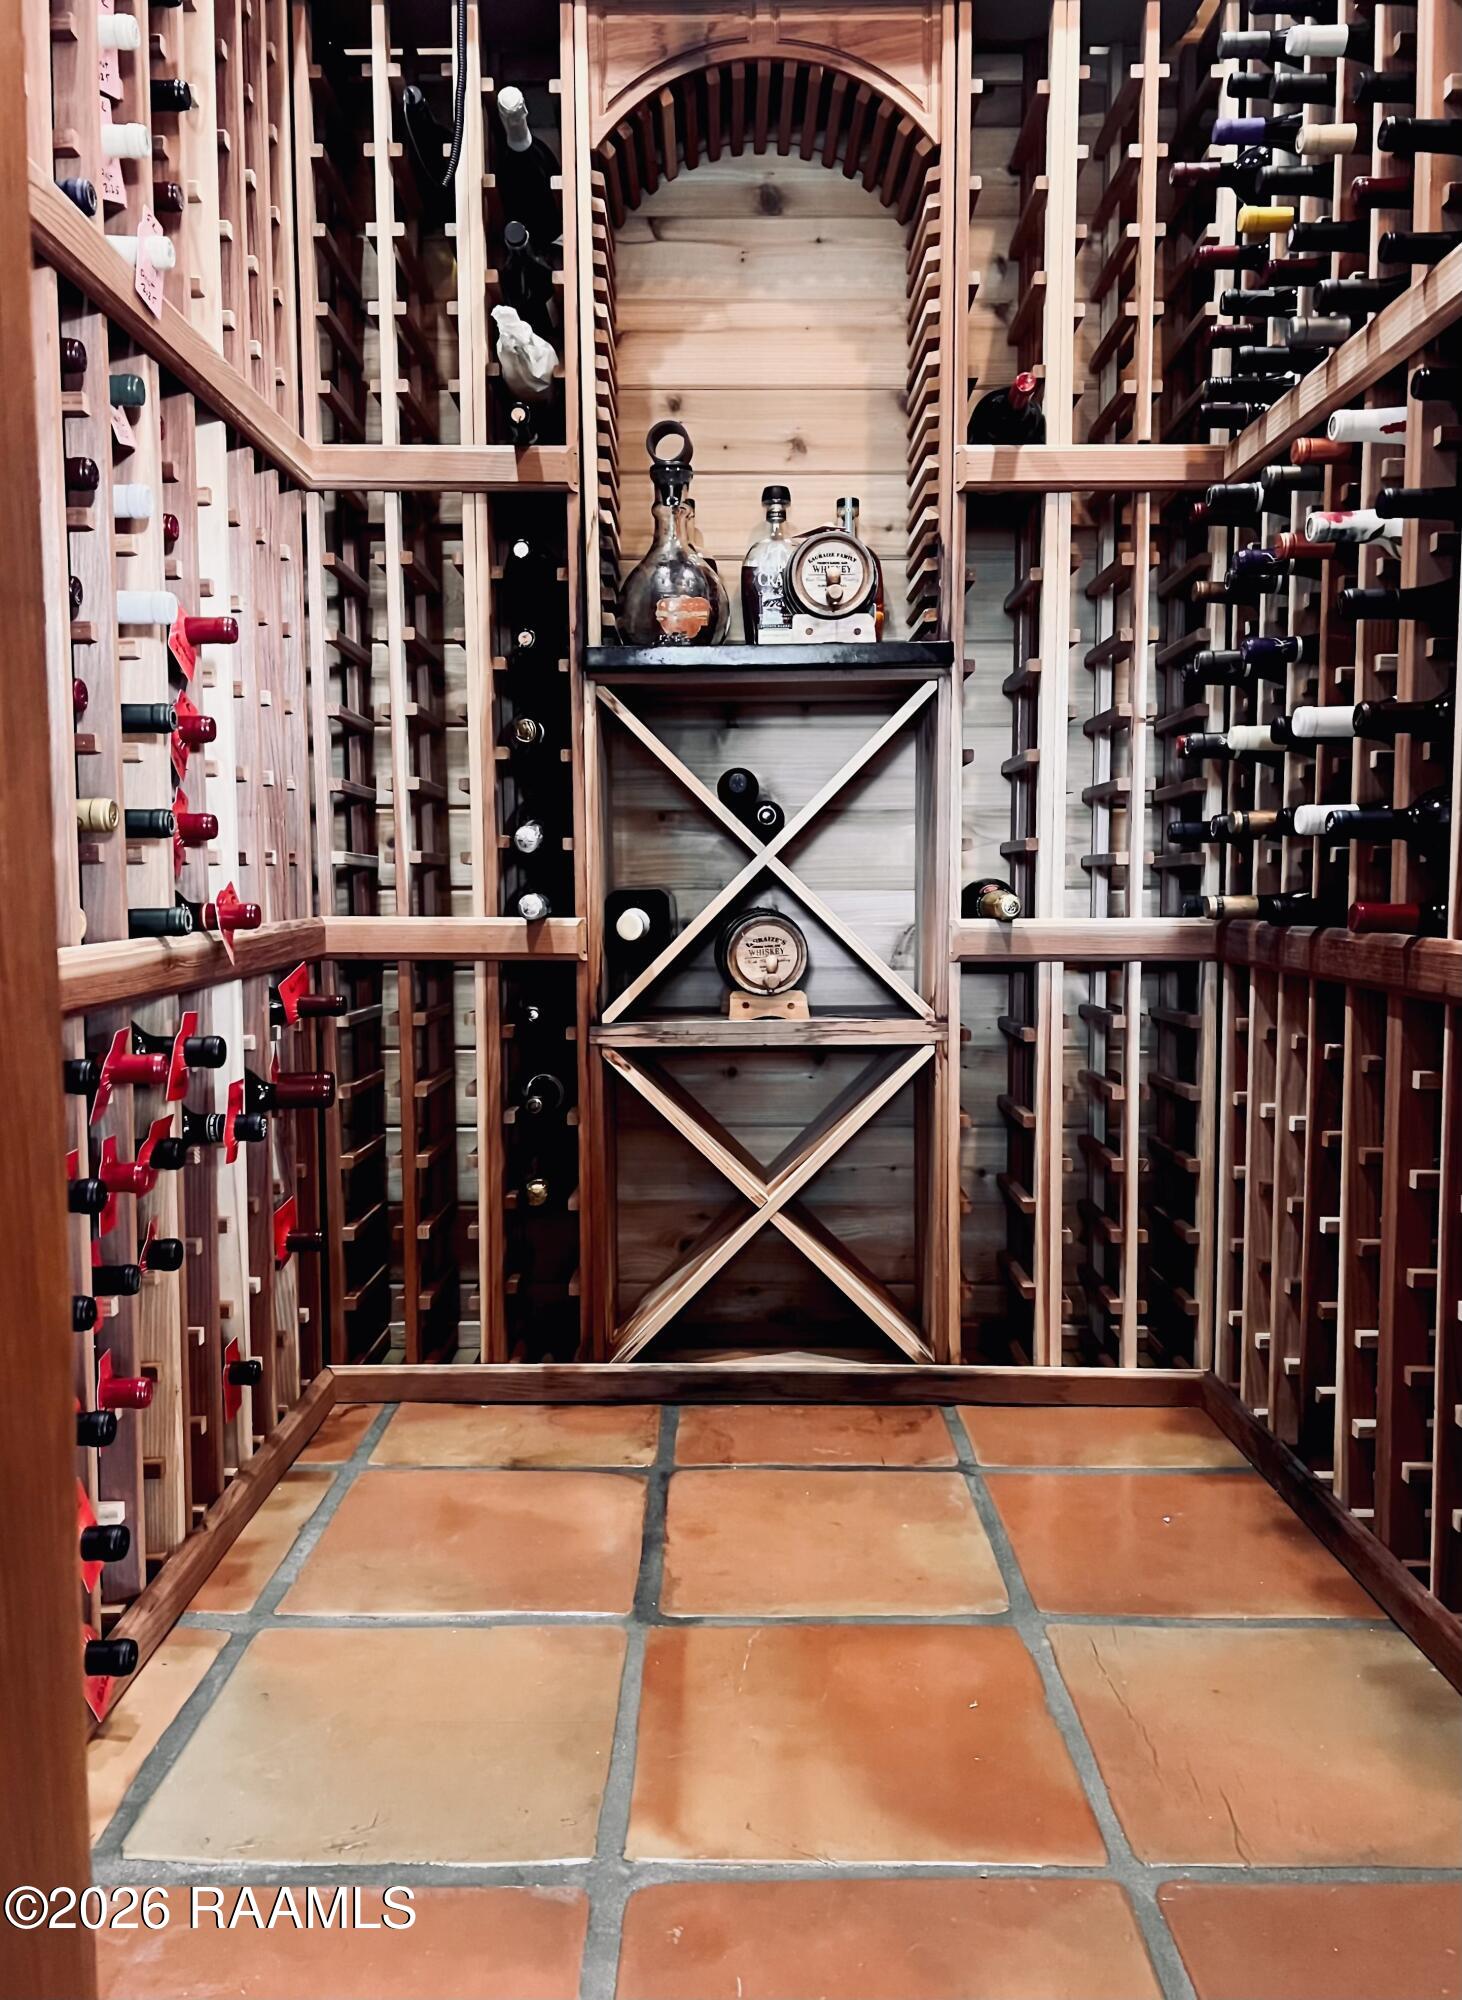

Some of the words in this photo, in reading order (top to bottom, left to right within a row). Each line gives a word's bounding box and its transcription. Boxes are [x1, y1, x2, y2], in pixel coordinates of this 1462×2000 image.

[836, 553, 857, 562] FAMILY
[812, 565, 851, 574] WHEY
[748, 948, 785, 956] WHISKEY
